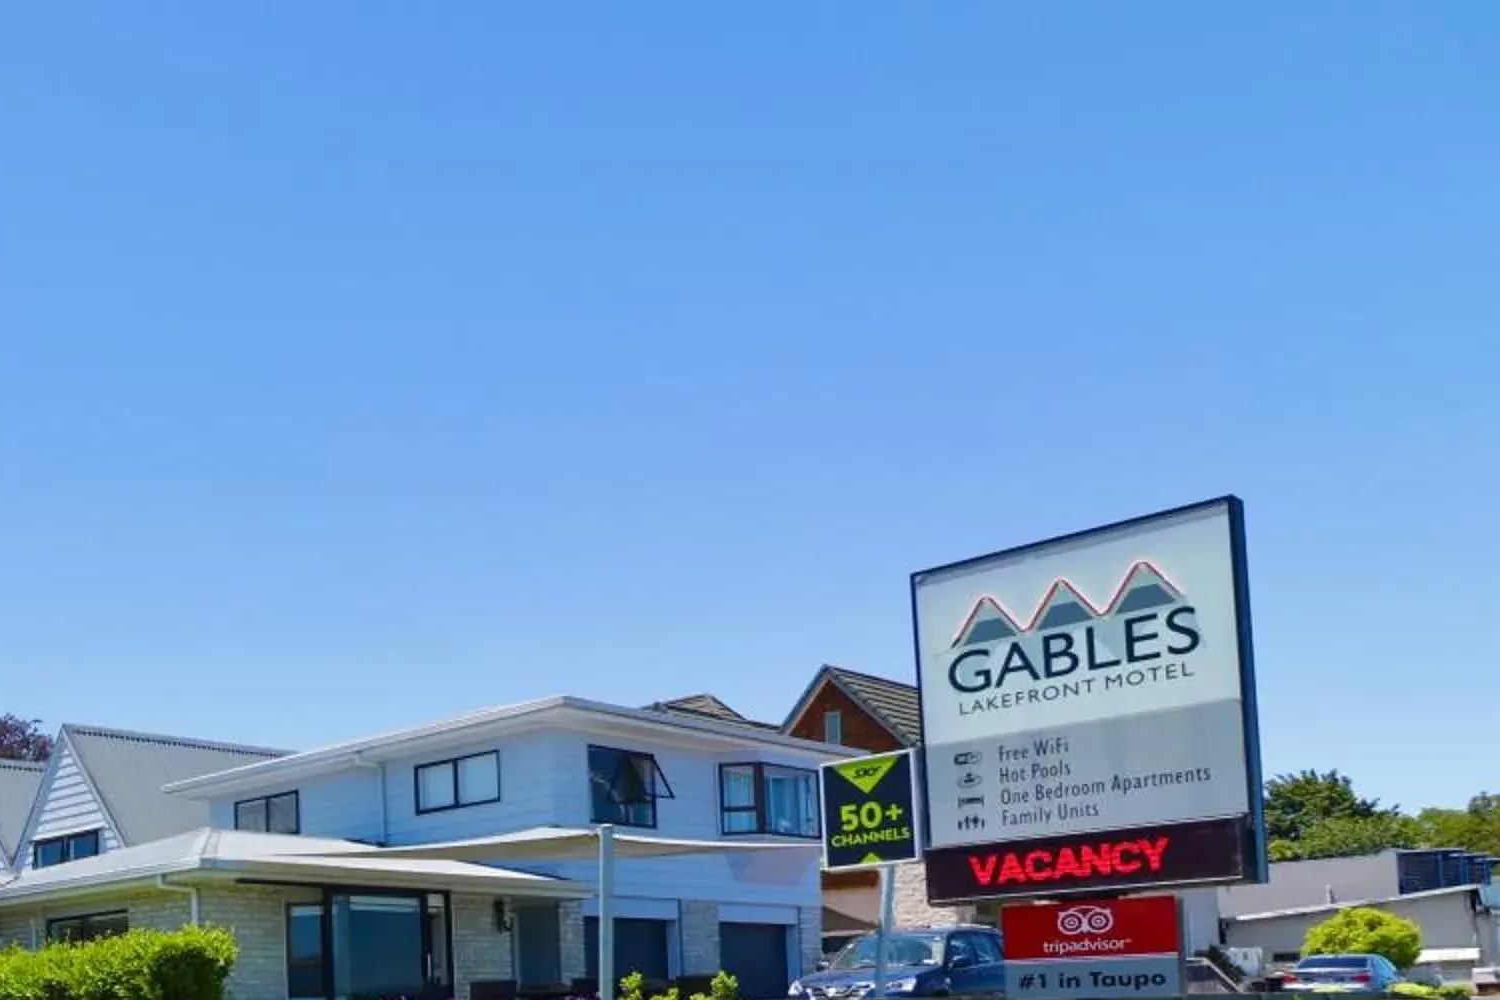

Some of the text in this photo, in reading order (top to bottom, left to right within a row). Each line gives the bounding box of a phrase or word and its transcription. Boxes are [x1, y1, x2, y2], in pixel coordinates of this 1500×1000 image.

[948, 606, 1201, 693] GABLES
[959, 661, 1195, 716] LAKEFRONT MOTEL
[998, 736, 1069, 762] Free WiFi
[999, 760, 1071, 784] Hot Pools
[1001, 766, 1212, 805] One Bedroom Apartments
[840, 801, 903, 832] 50+
[1001, 802, 1100, 827] Family Units
[831, 827, 911, 848] CHANNELS
[968, 836, 1169, 886] VACANCY
[1018, 971, 1166, 990] #1 in Taupo
